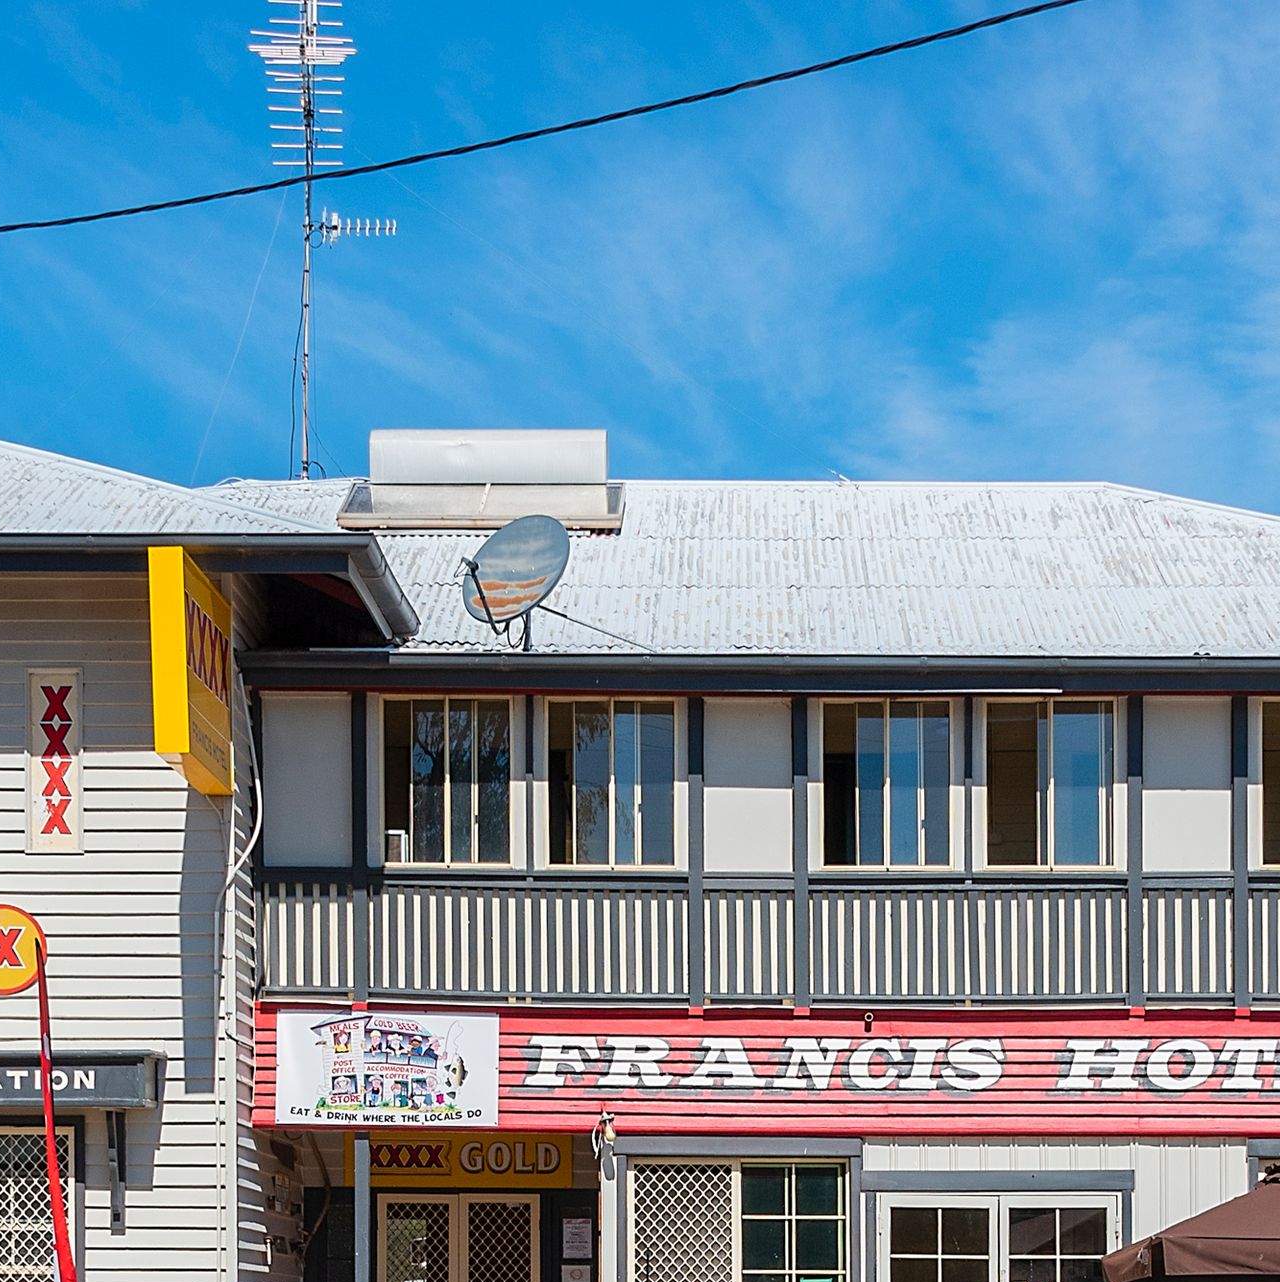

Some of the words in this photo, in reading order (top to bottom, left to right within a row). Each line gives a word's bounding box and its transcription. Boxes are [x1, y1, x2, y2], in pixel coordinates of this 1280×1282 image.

[328, 1022, 360, 1034] MEALS
[373, 1019, 394, 1029] COLD
[396, 1021, 423, 1033] BEER
[512, 1034, 1007, 1095] FRANCIS
[384, 1072, 410, 1080] COFFEE
[330, 1094, 362, 1104] STORE
[290, 1106, 311, 1117] EAT
[314, 1110, 322, 1118] &
[362, 1114, 396, 1123] WHERE
[401, 1114, 421, 1123] THE
[423, 1110, 463, 1122] LOCALS
[466, 1109, 482, 1119] DO
[459, 1141, 562, 1174] GOLD
